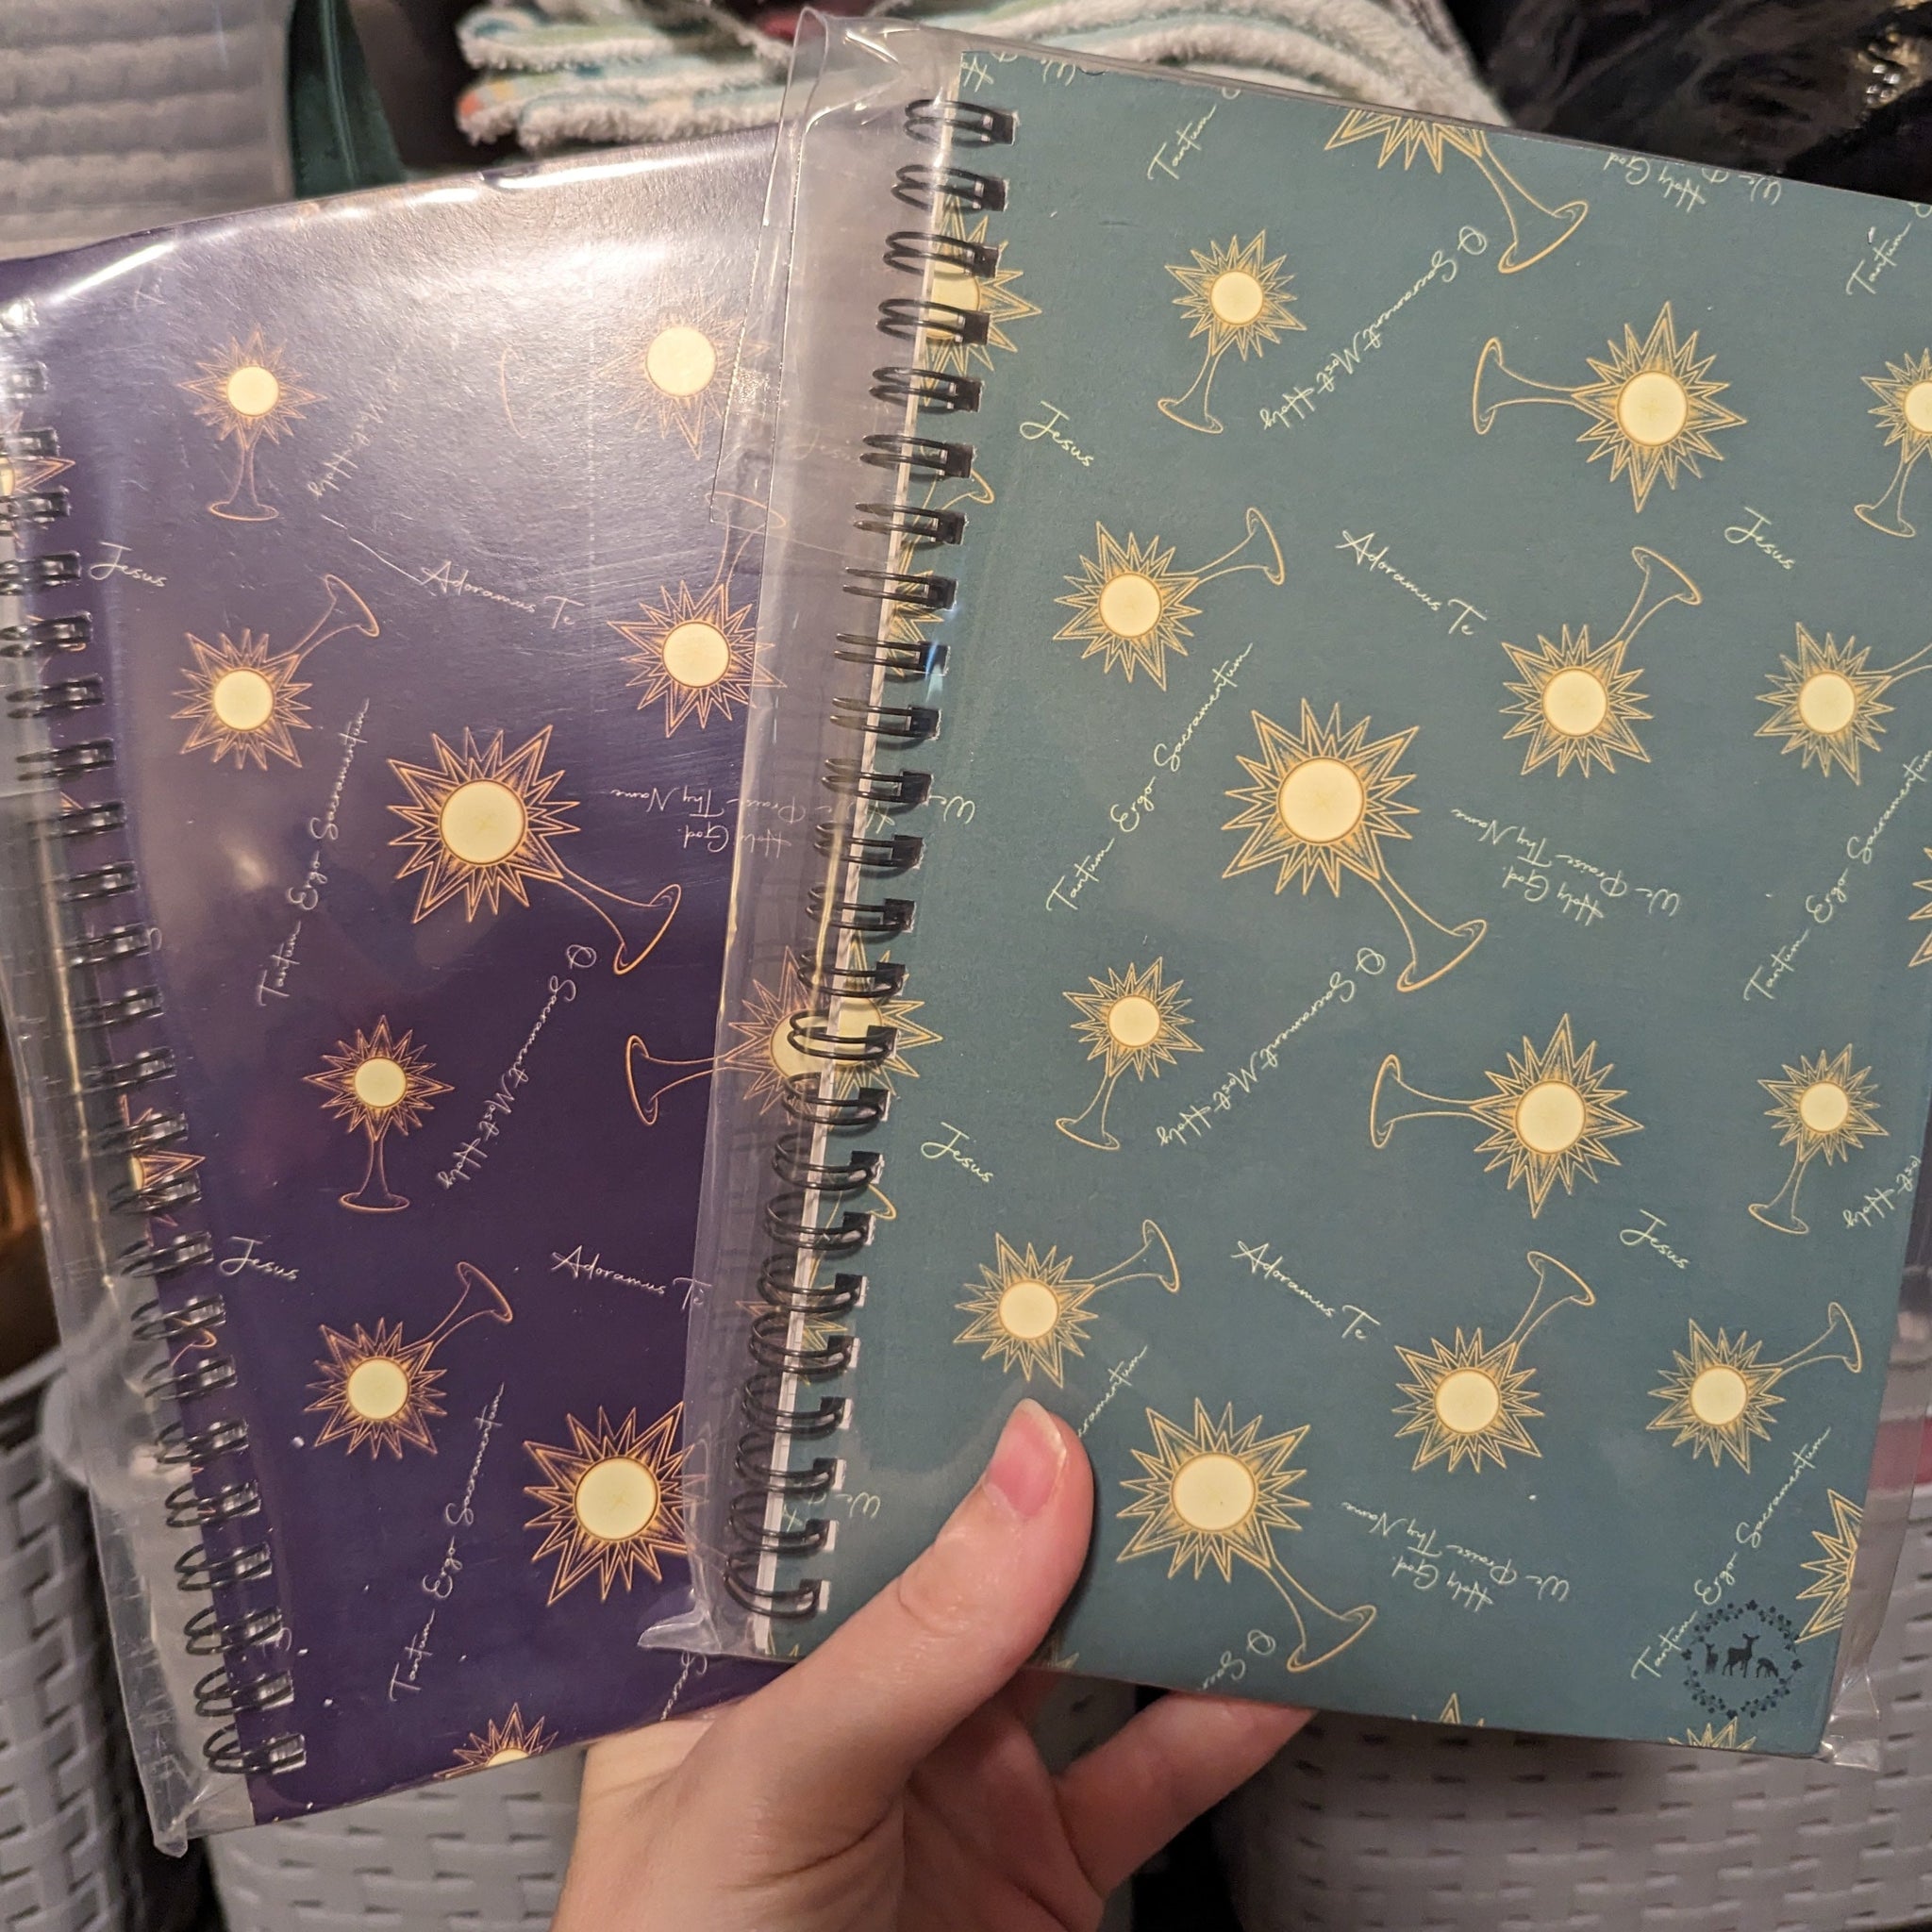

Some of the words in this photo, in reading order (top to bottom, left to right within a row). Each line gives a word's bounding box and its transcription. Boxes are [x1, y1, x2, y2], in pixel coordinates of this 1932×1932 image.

[1143, 104, 1218, 181] Tantum
[1658, 166, 1706, 213] Holy
[1457, 225, 1488, 255] O
[1845, 222, 1911, 295] Tantum
[1317, 331, 1360, 393] Most
[1259, 387, 1316, 430] Holy
[1019, 400, 1094, 467] Jesus
[1724, 507, 1796, 570] Jesus
[89, 541, 168, 587] Jesus
[1335, 529, 1442, 611] Adoramus
[1447, 599, 1488, 635] Te
[420, 560, 538, 613] Adoramus
[543, 595, 585, 629] Te
[1045, 838, 1115, 911] Tantum
[1109, 775, 1157, 832] Ergo
[1154, 642, 1254, 772] Sacramentum
[611, 787, 679, 813] Name
[682, 786, 725, 818] Thy
[1449, 808, 1518, 845] Name
[1516, 826, 1553, 868] Thy
[257, 920, 302, 1007] Tantum
[287, 850, 327, 910] Ergo
[309, 697, 371, 841] Sacramentum
[1555, 854, 1628, 897] Praise
[1557, 881, 1605, 926] Holy
[1635, 889, 1681, 917] We
[566, 944, 597, 970] O
[1743, 928, 1809, 1001] Tantum
[1805, 868, 1849, 924] Ergo
[1356, 947, 1386, 975] O
[1213, 1052, 1258, 1112] Most
[477, 1074, 516, 1141] Most
[1156, 1105, 1212, 1146] Holy
[437, 1137, 489, 1190] Holy
[920, 1121, 994, 1183] Jesus
[1842, 1187, 1896, 1229] Holy
[219, 1236, 300, 1281] Jesus
[1619, 1208, 1691, 1270] Jesus
[551, 1244, 666, 1294] Adoramus
[672, 1276, 712, 1311] Te
[1230, 1240, 1337, 1318] Adoramus
[1341, 1305, 1382, 1340] Te
[1341, 1501, 1408, 1537] Name
[1407, 1518, 1443, 1557] Thy
[389, 1607, 437, 1703] Tantum
[422, 1535, 463, 1598] Ergo
[444, 1382, 506, 1526] Sacramentum
[1445, 1543, 1518, 1586] Praise
[1630, 1609, 1698, 1680] Tantum
[1693, 1552, 1739, 1606] Ergo
[1736, 1426, 1832, 1549] Sacramentum
[1446, 1569, 1494, 1612] Holy
[1524, 1574, 1570, 1602] We
[1246, 1629, 1276, 1656] O
